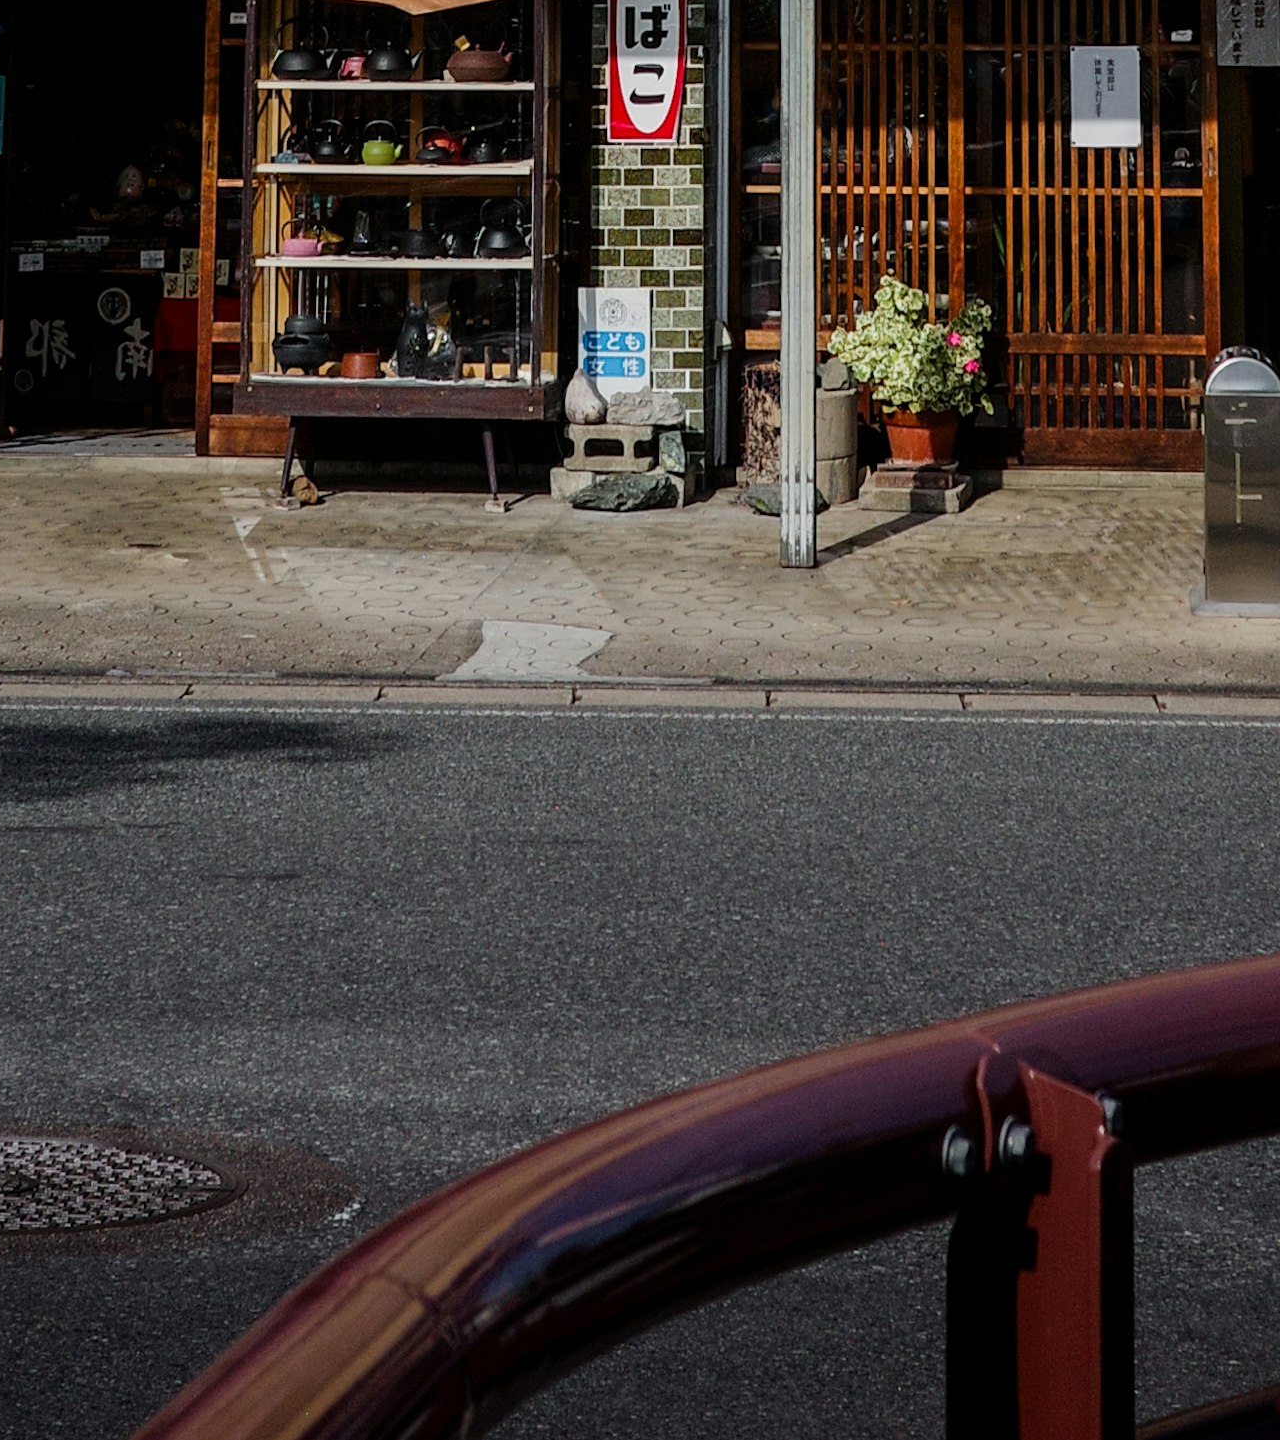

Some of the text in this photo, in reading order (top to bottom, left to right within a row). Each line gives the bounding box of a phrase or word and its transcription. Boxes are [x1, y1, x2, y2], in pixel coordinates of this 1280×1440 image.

[588, 332, 640, 351] こども
[588, 357, 640, 376] 女性
